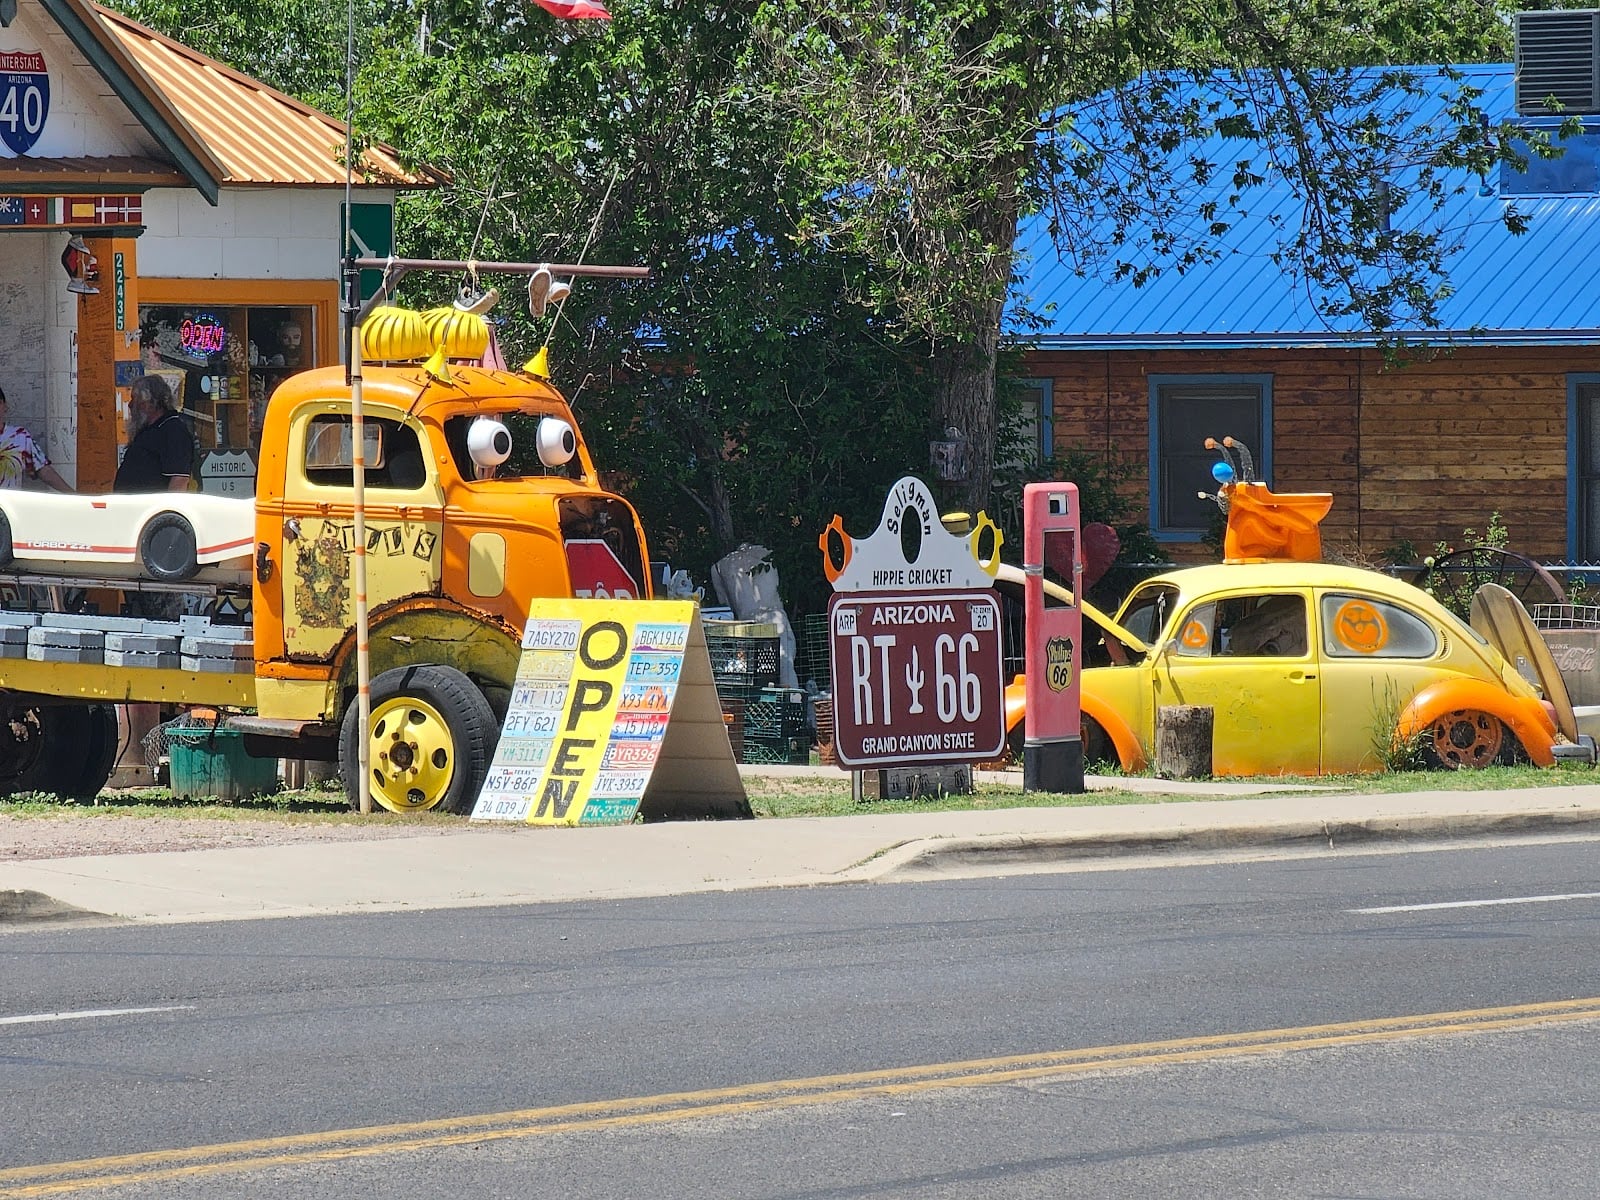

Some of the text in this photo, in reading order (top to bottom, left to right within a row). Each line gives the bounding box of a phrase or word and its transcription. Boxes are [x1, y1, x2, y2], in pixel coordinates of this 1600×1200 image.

[0, 56, 40, 70] NTERSTATE
[8, 75, 33, 84] ARIZONA
[0, 86, 42, 134] 40
[115, 253, 124, 330] 22435
[181, 319, 224, 351] OPEN
[211, 462, 246, 473] HISTORIC
[887, 482, 931, 535] Seligman
[873, 569, 953, 586] HIPPIE CRICKET
[838, 614, 855, 631] ARP
[871, 604, 956, 626] ARIZONA
[977, 615, 987, 628] 20
[528, 630, 576, 647] 7AGY270
[639, 630, 684, 646] BGK1916
[630, 662, 679, 676] TEP 359
[1053, 665, 1068, 686] 66
[851, 633, 981, 726] RT 66
[514, 690, 563, 705] CWT 113
[506, 715, 556, 732] 2FY 621
[534, 620, 628, 819] OPEN
[862, 732, 976, 754] GRAND CANYON STATE
[608, 747, 656, 761] BYR396
